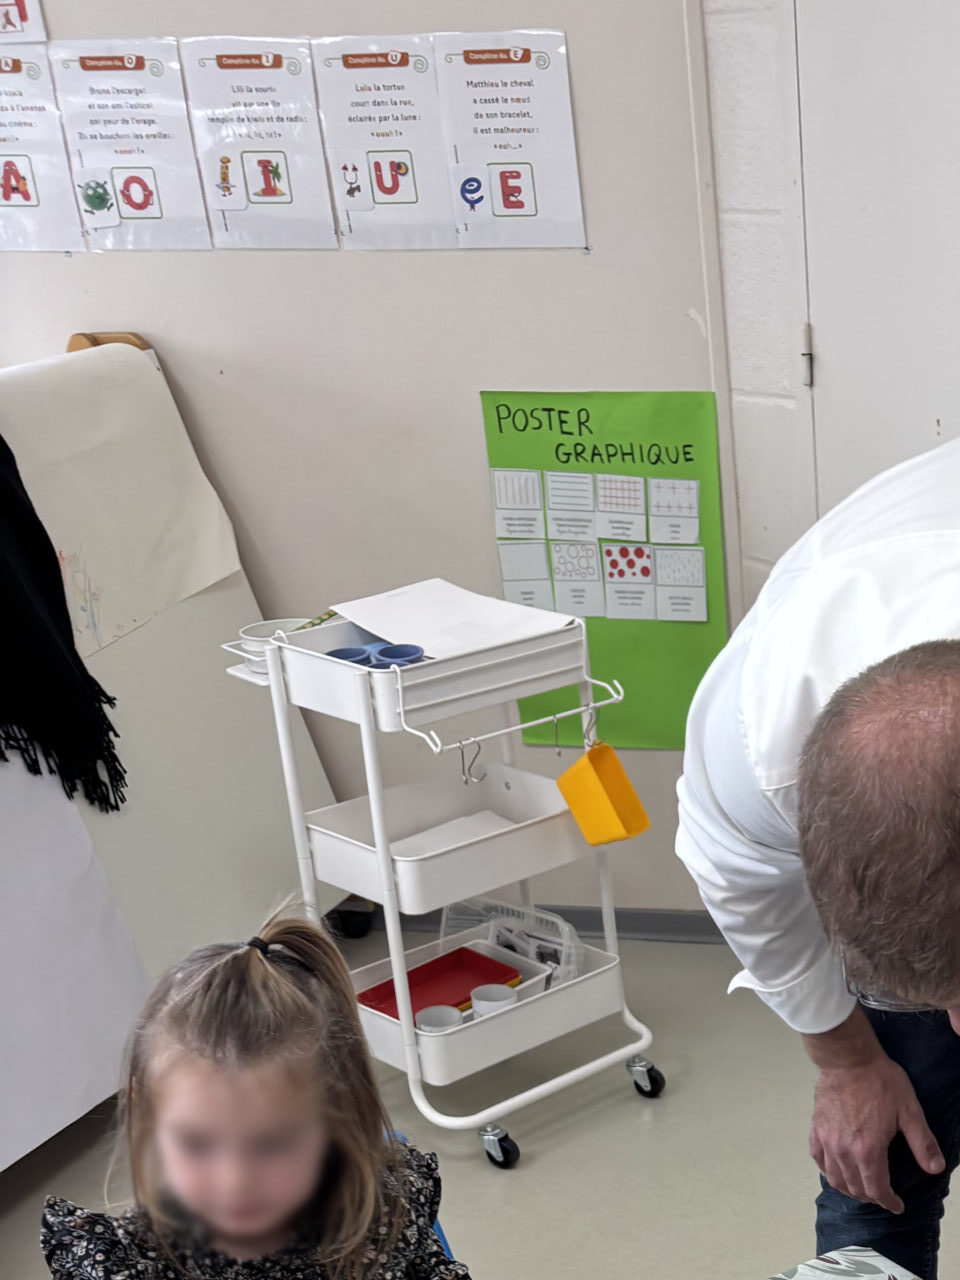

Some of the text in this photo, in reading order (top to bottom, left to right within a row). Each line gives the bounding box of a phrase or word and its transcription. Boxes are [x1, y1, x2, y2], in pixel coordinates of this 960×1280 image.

[2, 160, 31, 201] A
[121, 175, 152, 211] O
[374, 160, 399, 195] U
[499, 170, 525, 209] E
[495, 402, 593, 437] POSTER
[554, 442, 695, 466] GRAPHIQUE
